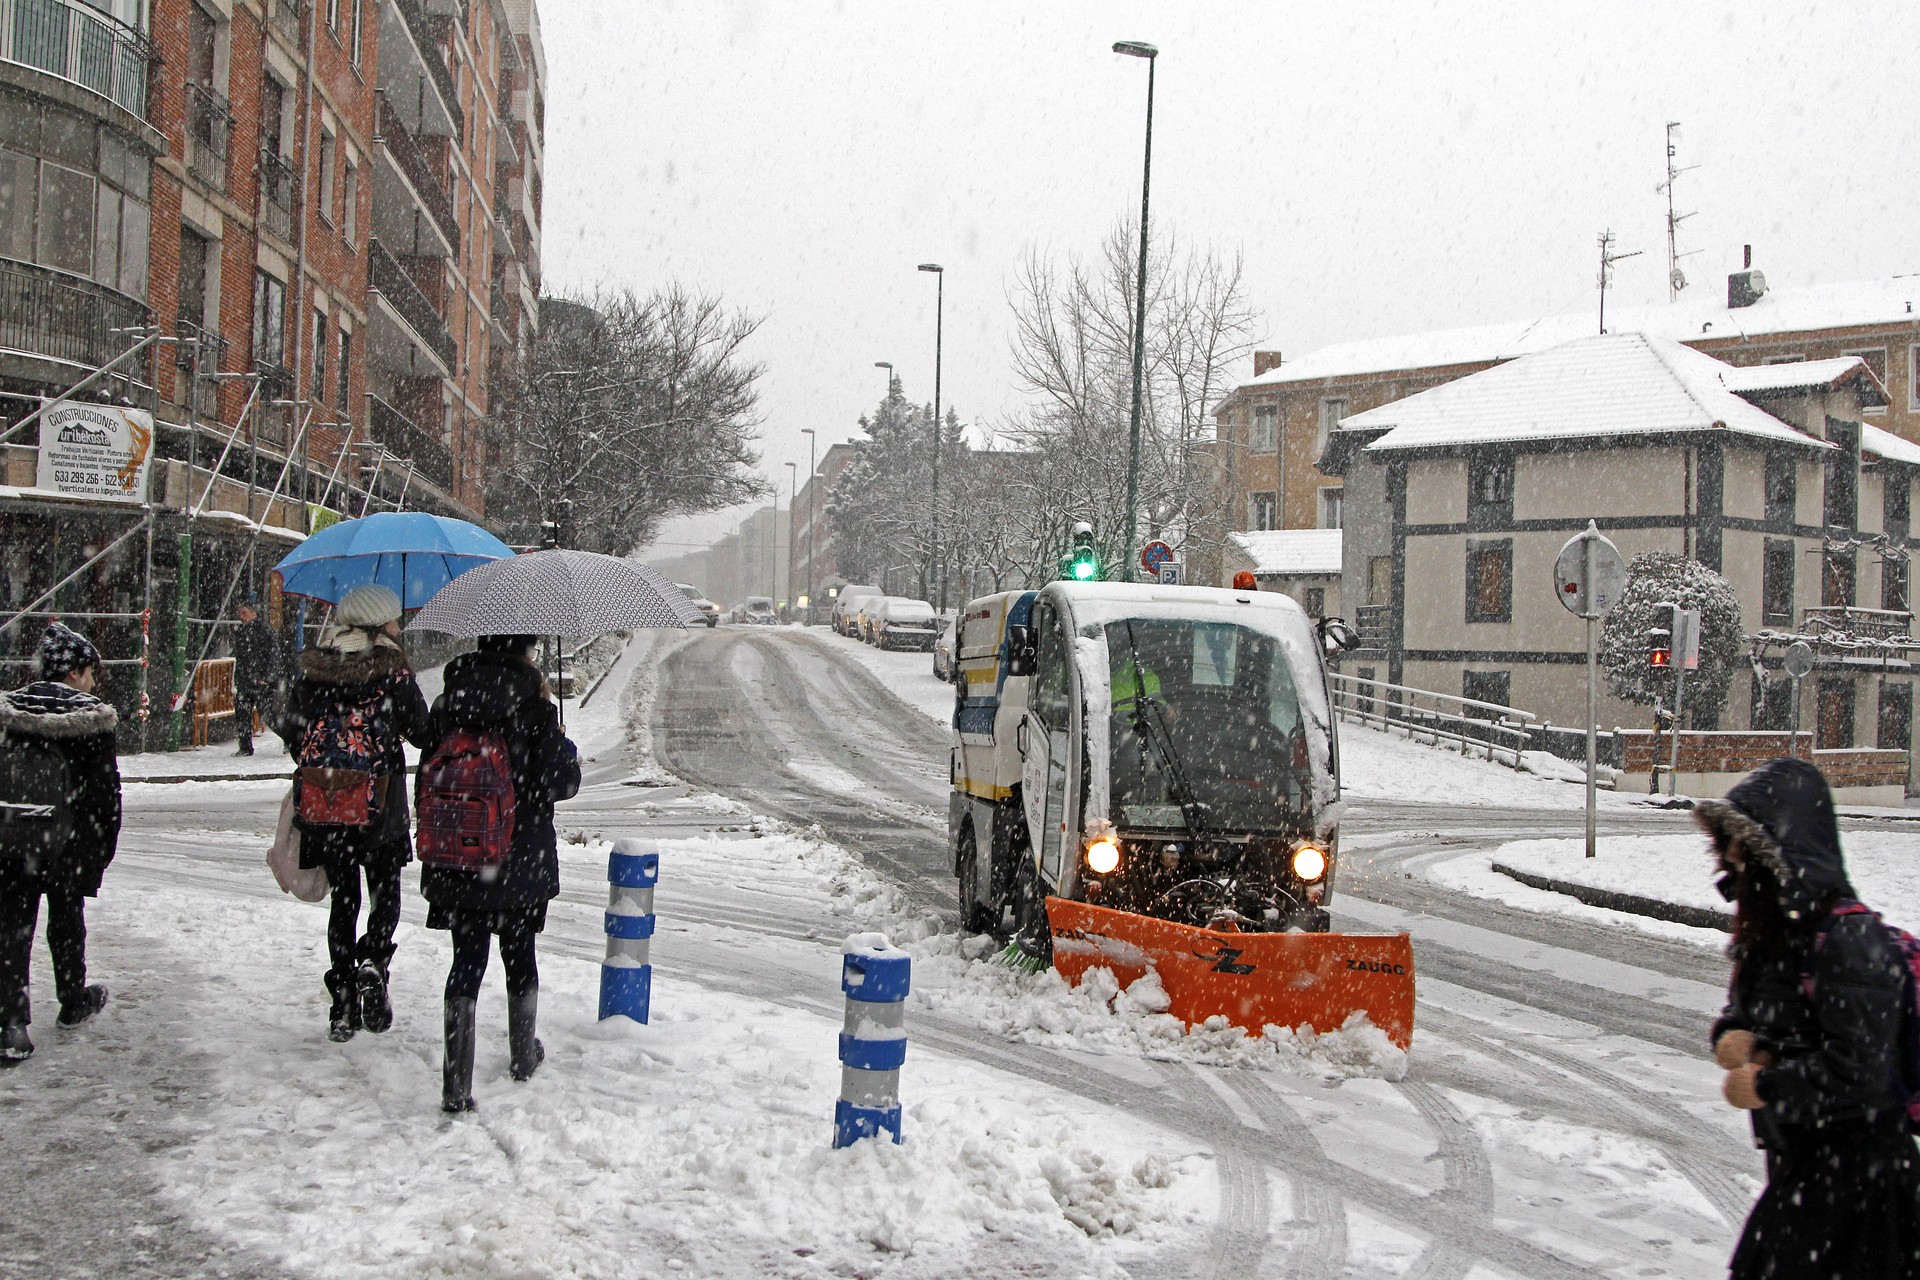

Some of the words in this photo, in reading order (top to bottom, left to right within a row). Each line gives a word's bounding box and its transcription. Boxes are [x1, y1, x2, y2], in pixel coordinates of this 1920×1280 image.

[48, 408, 119, 433] CONSTRUCCIONES
[55, 470, 69, 482] 633
[70, 471, 85, 484] 299
[85, 472, 99, 485] 256
[105, 474, 118, 486] 622
[1055, 927, 1107, 941] ZAU
[1345, 959, 1406, 976] ZAUGG
